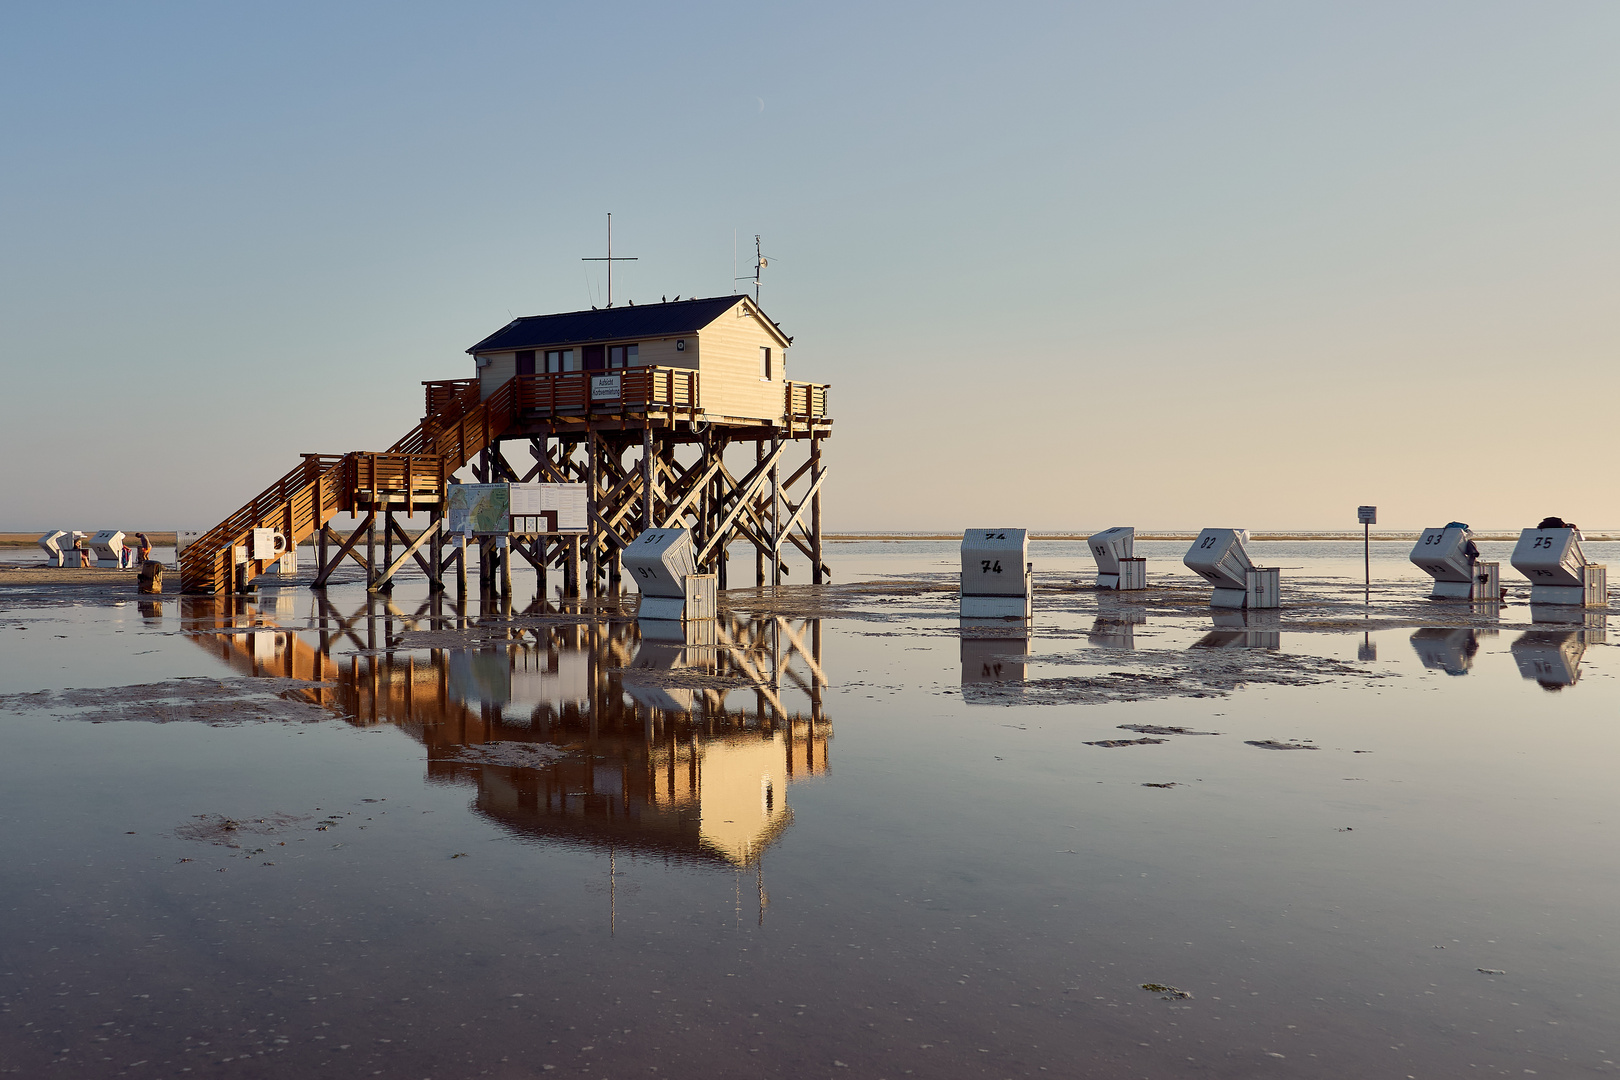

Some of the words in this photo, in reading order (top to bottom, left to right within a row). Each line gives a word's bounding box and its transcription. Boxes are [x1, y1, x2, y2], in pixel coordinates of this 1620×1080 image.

[644, 534, 666, 545] 91
[1201, 536, 1216, 549] 82
[1425, 534, 1443, 545] 93
[1533, 536, 1554, 549] 75
[637, 566, 658, 579] 91
[980, 560, 1003, 574] 74
[1426, 565, 1447, 573] 93
[1531, 569, 1554, 577] 75
